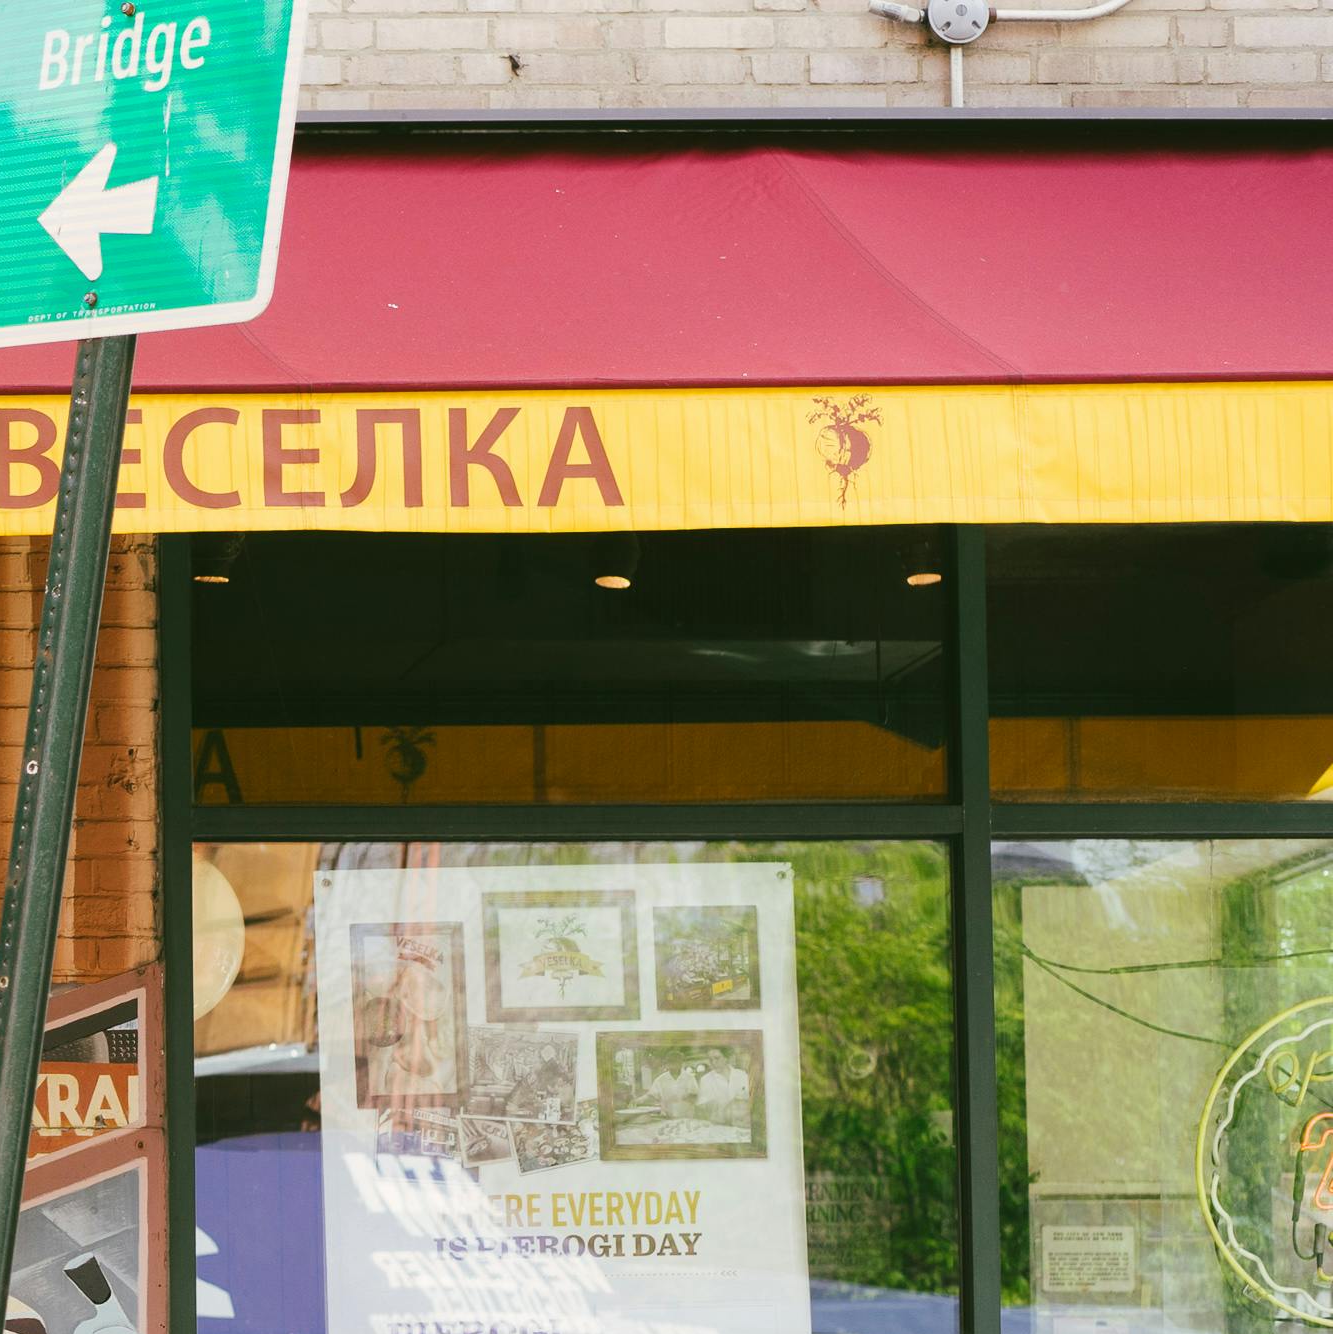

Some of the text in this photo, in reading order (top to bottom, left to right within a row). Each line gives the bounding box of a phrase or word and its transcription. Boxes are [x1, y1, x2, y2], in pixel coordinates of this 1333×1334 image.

[39, 13, 211, 92] Bridge
[29, 303, 158, 323] DEPT OF TRANSPORTATION
[551, 1189, 701, 1228] EVERYDAY
[631, 1232, 703, 1257] DAY
